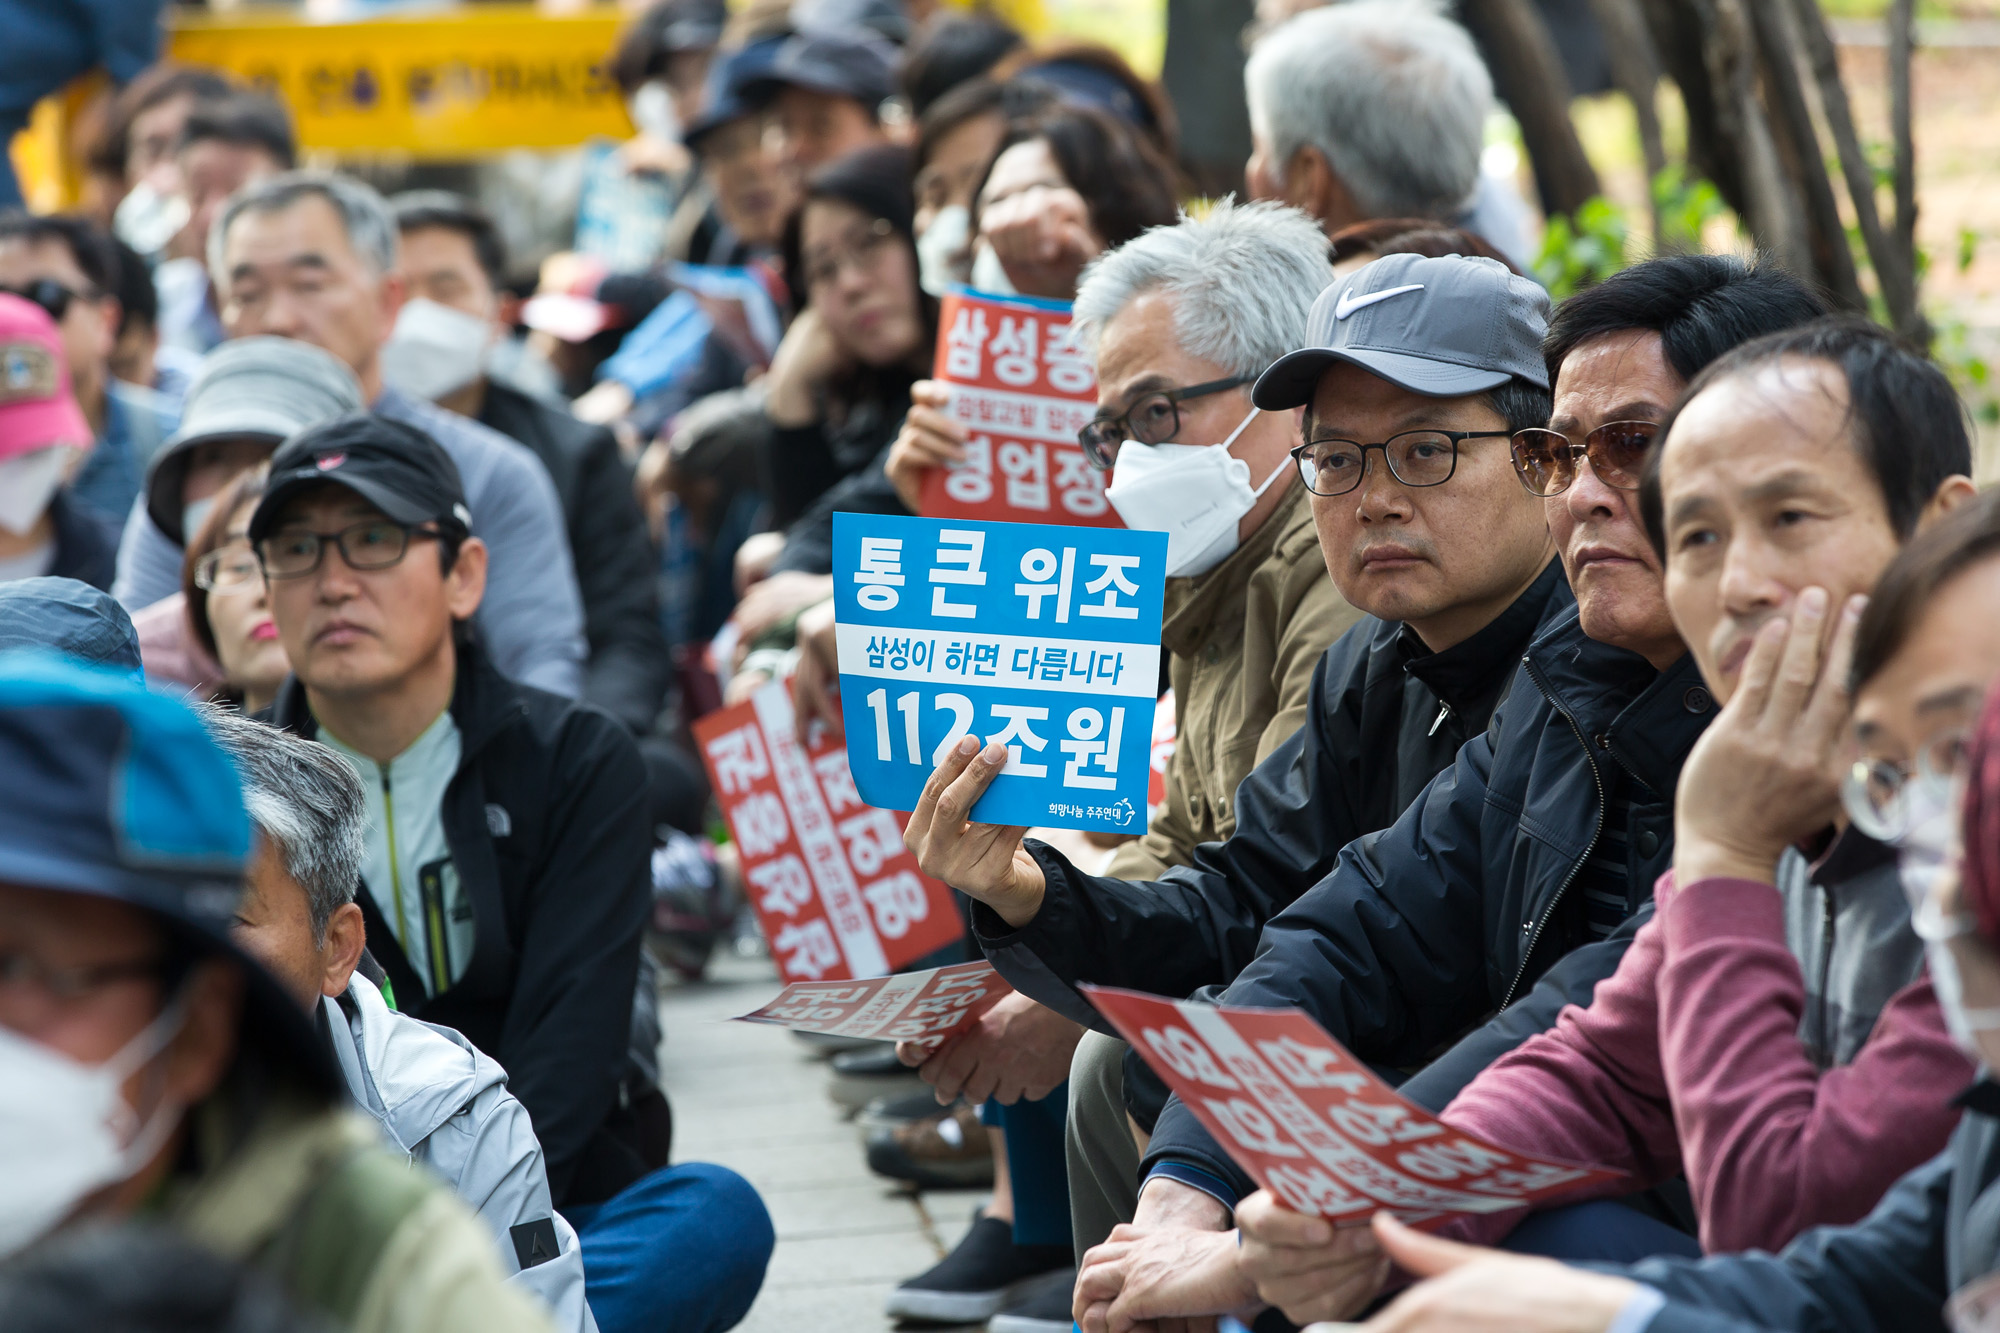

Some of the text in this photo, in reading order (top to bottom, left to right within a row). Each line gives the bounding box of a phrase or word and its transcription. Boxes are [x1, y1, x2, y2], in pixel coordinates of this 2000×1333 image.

[946, 308, 1096, 394] 삼성증
[945, 435, 1109, 517] 영업정
[854, 528, 1141, 624] 통 큰 위조
[865, 636, 1124, 686] 삼성이 하면 다릅니다
[866, 688, 1126, 791] 112조원
[707, 721, 841, 980] 삼성증권
[808, 718, 929, 939] 영업정
[1048, 803, 1121, 821] 희망나눔 주주연대
[1142, 1025, 1420, 1222] 영업정
[1256, 1036, 1591, 1196] 삼성증권
